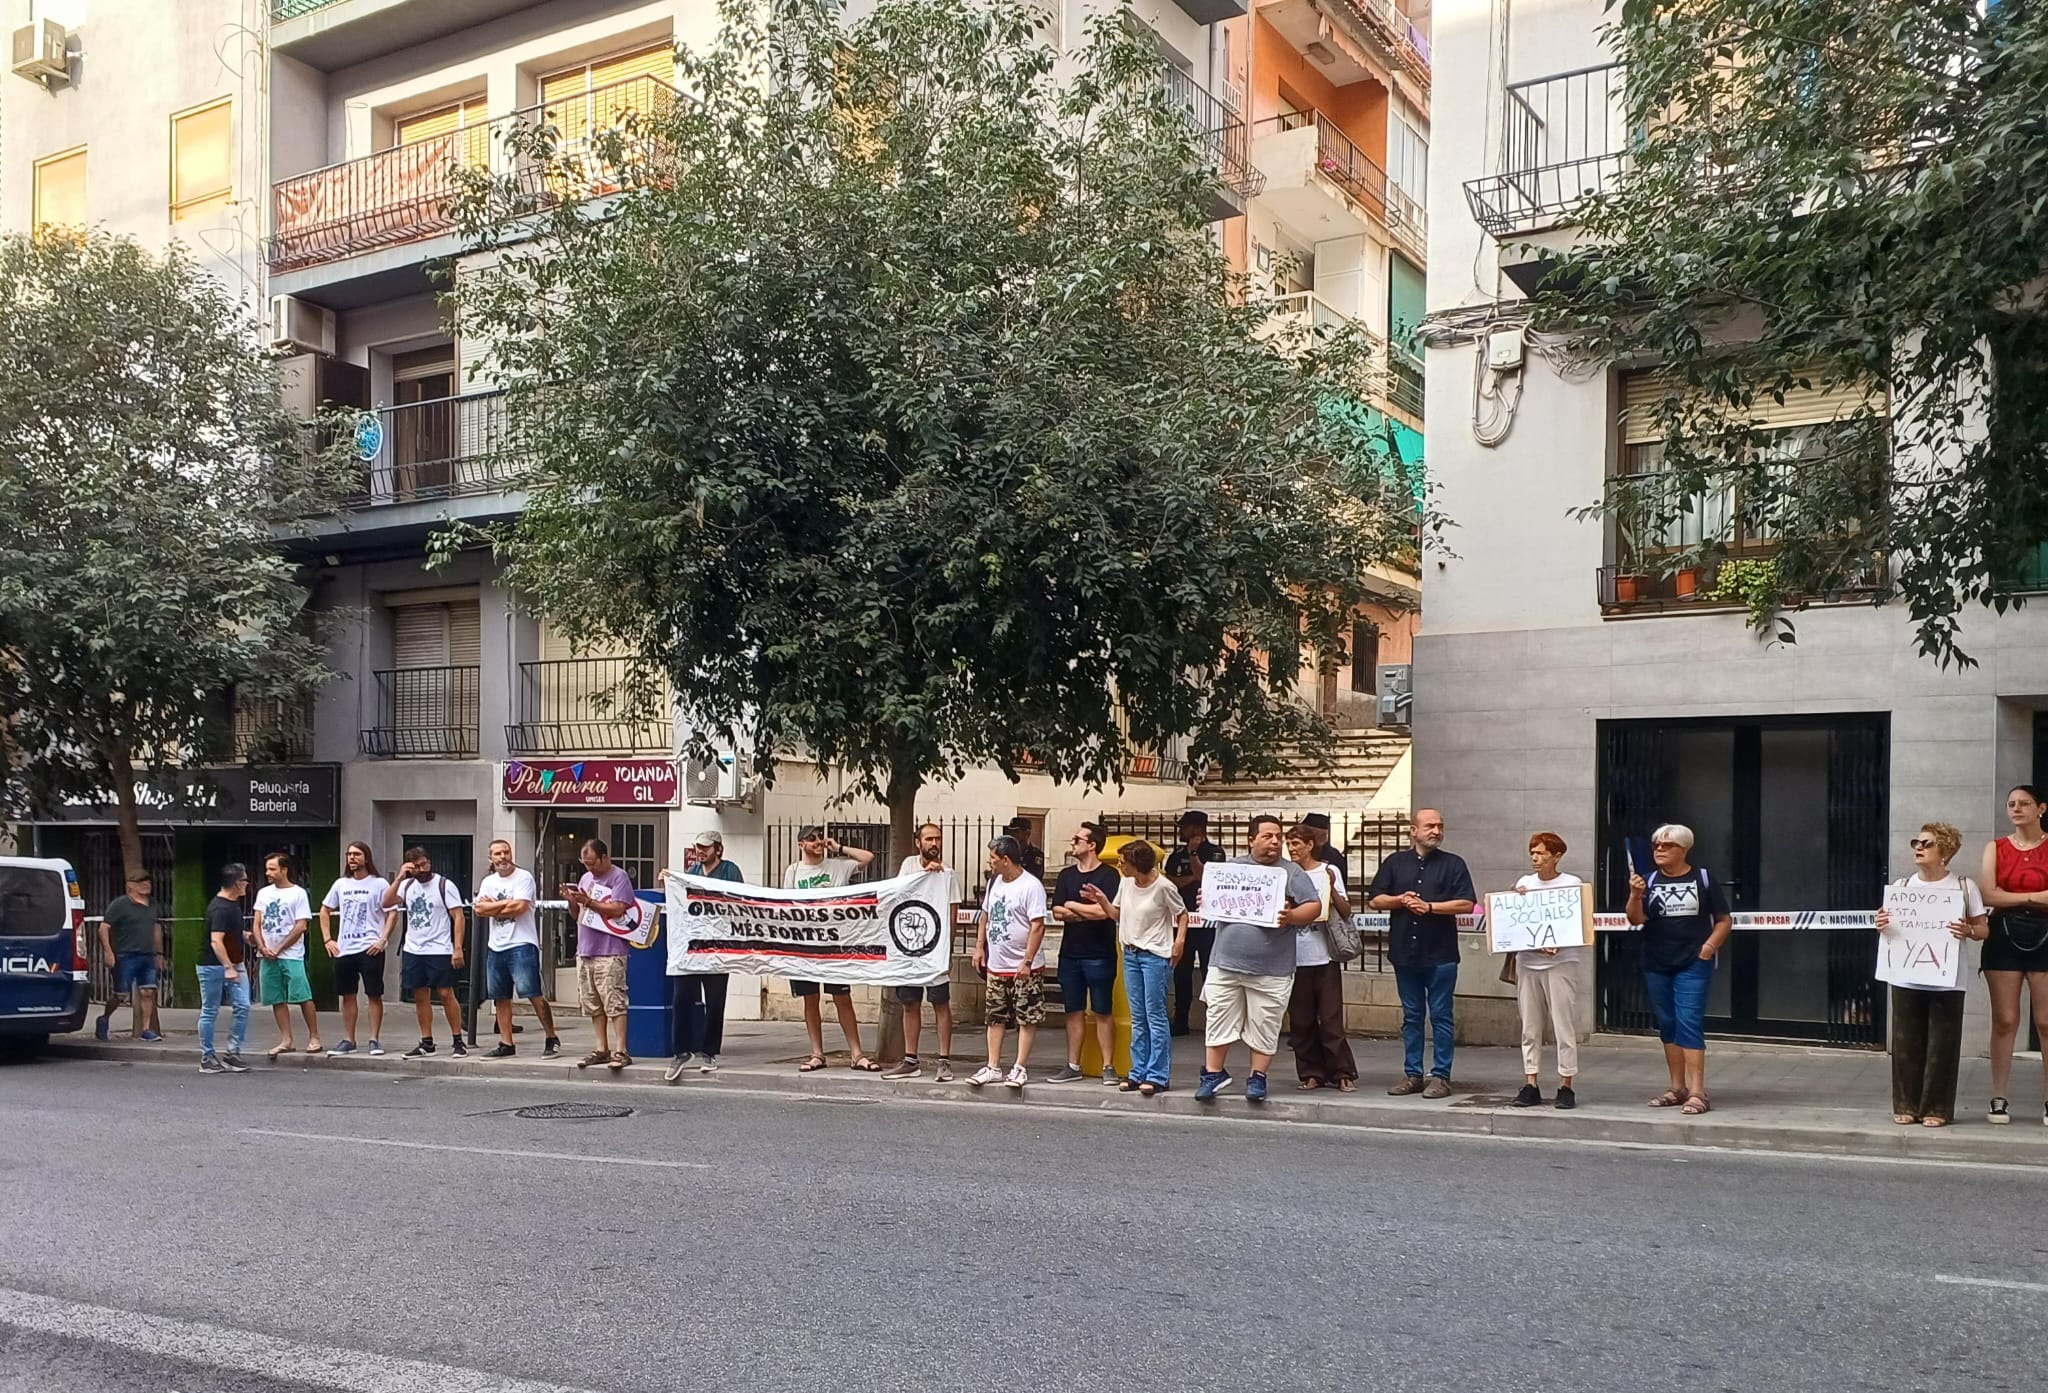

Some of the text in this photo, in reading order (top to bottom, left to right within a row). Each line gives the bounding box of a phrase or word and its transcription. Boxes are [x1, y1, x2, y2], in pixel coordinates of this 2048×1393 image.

[614, 766, 674, 782] YOLANDA
[633, 786, 654, 801] GIL
[1494, 889, 1580, 912] ALQUILERES
[1890, 892, 1937, 904] APOYO
[688, 901, 879, 922] ORGANITZADES SOM
[958, 912, 971, 921] ASAR
[1509, 904, 1574, 927] SOCIALES
[640, 911, 653, 938] STOP
[1364, 917, 1390, 926] NACION
[1457, 917, 1474, 926] ASAR
[1604, 917, 1626, 926] PASAR
[1753, 916, 1791, 925] NO PASAR
[1829, 915, 1867, 925] NACIONAL
[1900, 921, 1946, 929] FAMILI
[730, 919, 839, 941] MÉS FORTES
[1526, 924, 1557, 947] YA
[0, 954, 50, 972] ICÍA
